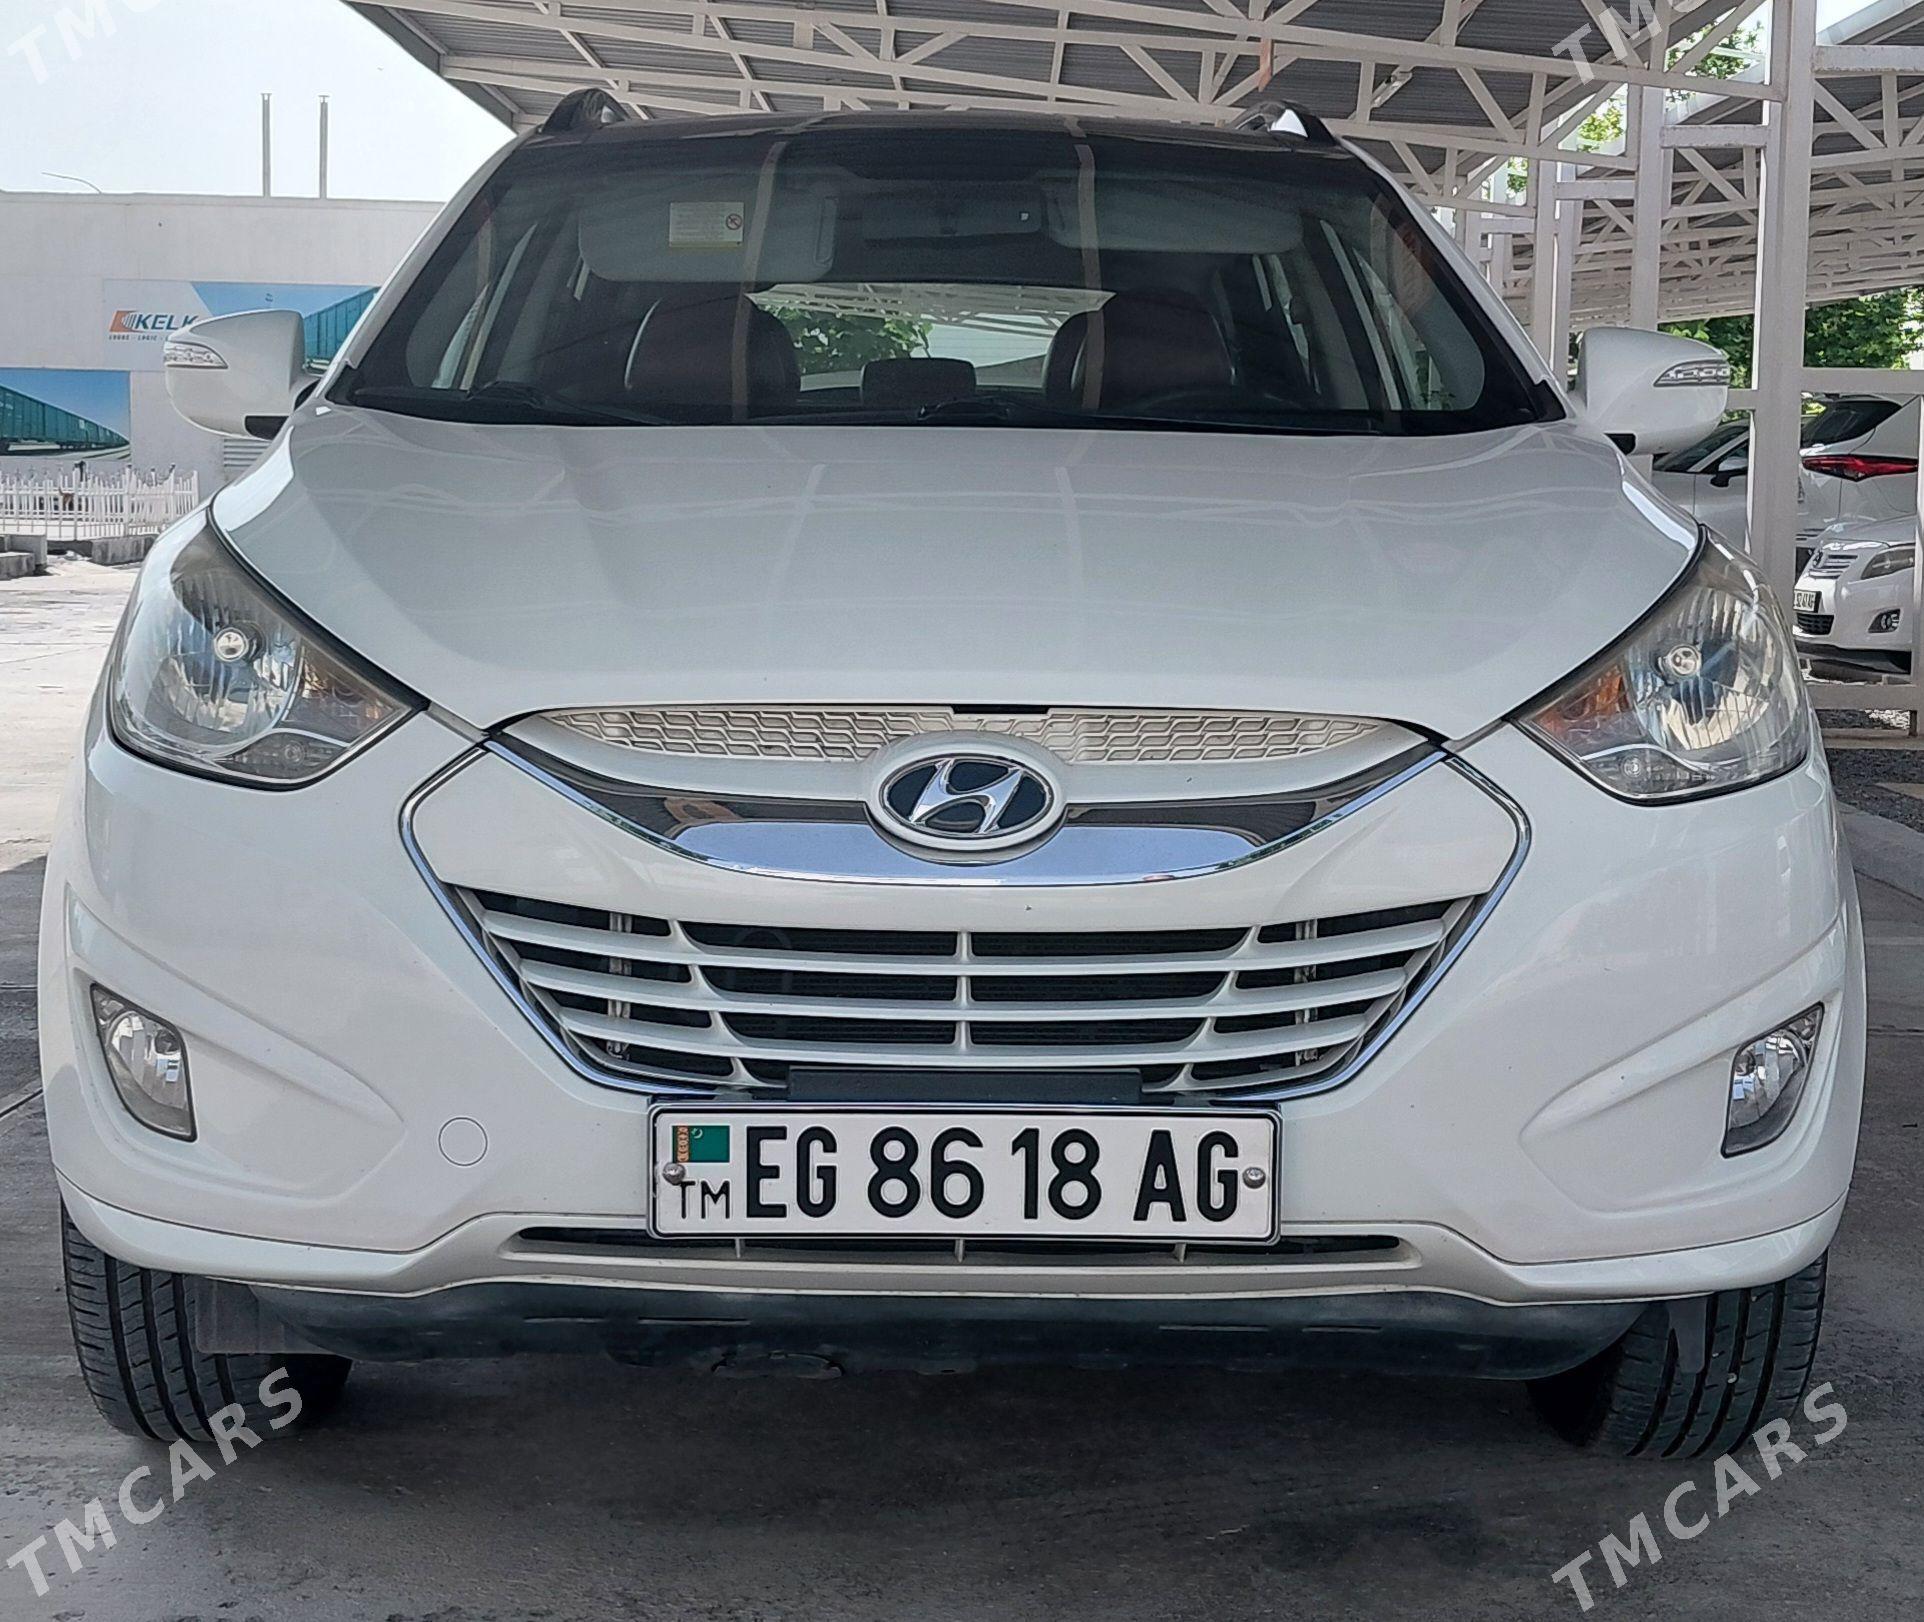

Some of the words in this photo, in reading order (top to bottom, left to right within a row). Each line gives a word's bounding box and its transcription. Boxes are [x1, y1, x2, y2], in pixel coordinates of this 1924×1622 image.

[680, 1180, 730, 1219] TM
[746, 1126, 837, 1218] EG
[867, 1126, 985, 1219] 86
[1011, 1128, 1102, 1220] 18
[1133, 1130, 1239, 1222] AG
